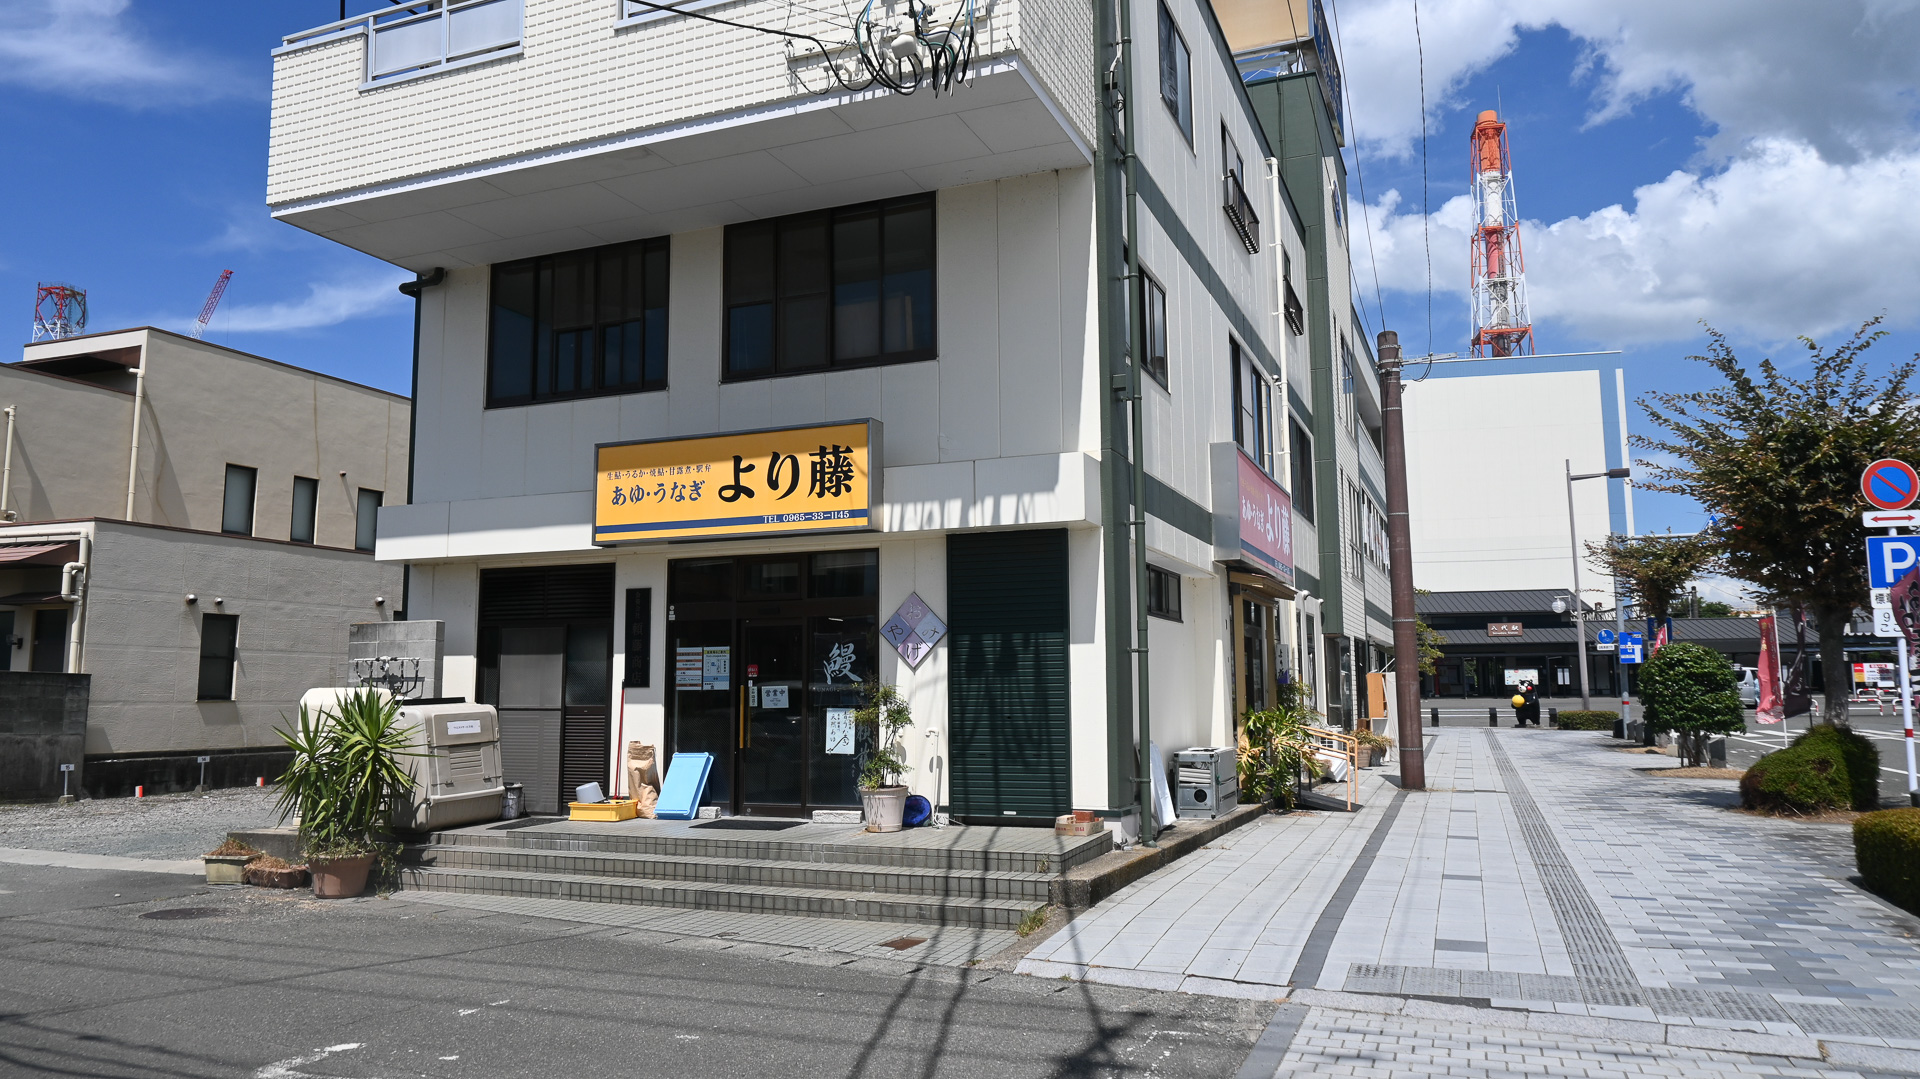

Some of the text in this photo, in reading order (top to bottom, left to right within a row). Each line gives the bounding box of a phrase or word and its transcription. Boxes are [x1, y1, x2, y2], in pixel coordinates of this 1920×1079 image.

[611, 480, 706, 507] あゆ・うなぎ
[718, 444, 855, 503] より藤
[763, 510, 850, 523] TEL 0965-33-1145
[1265, 493, 1291, 557] より藤
[1882, 542, 1917, 584] P
[823, 642, 863, 685] 鰻
